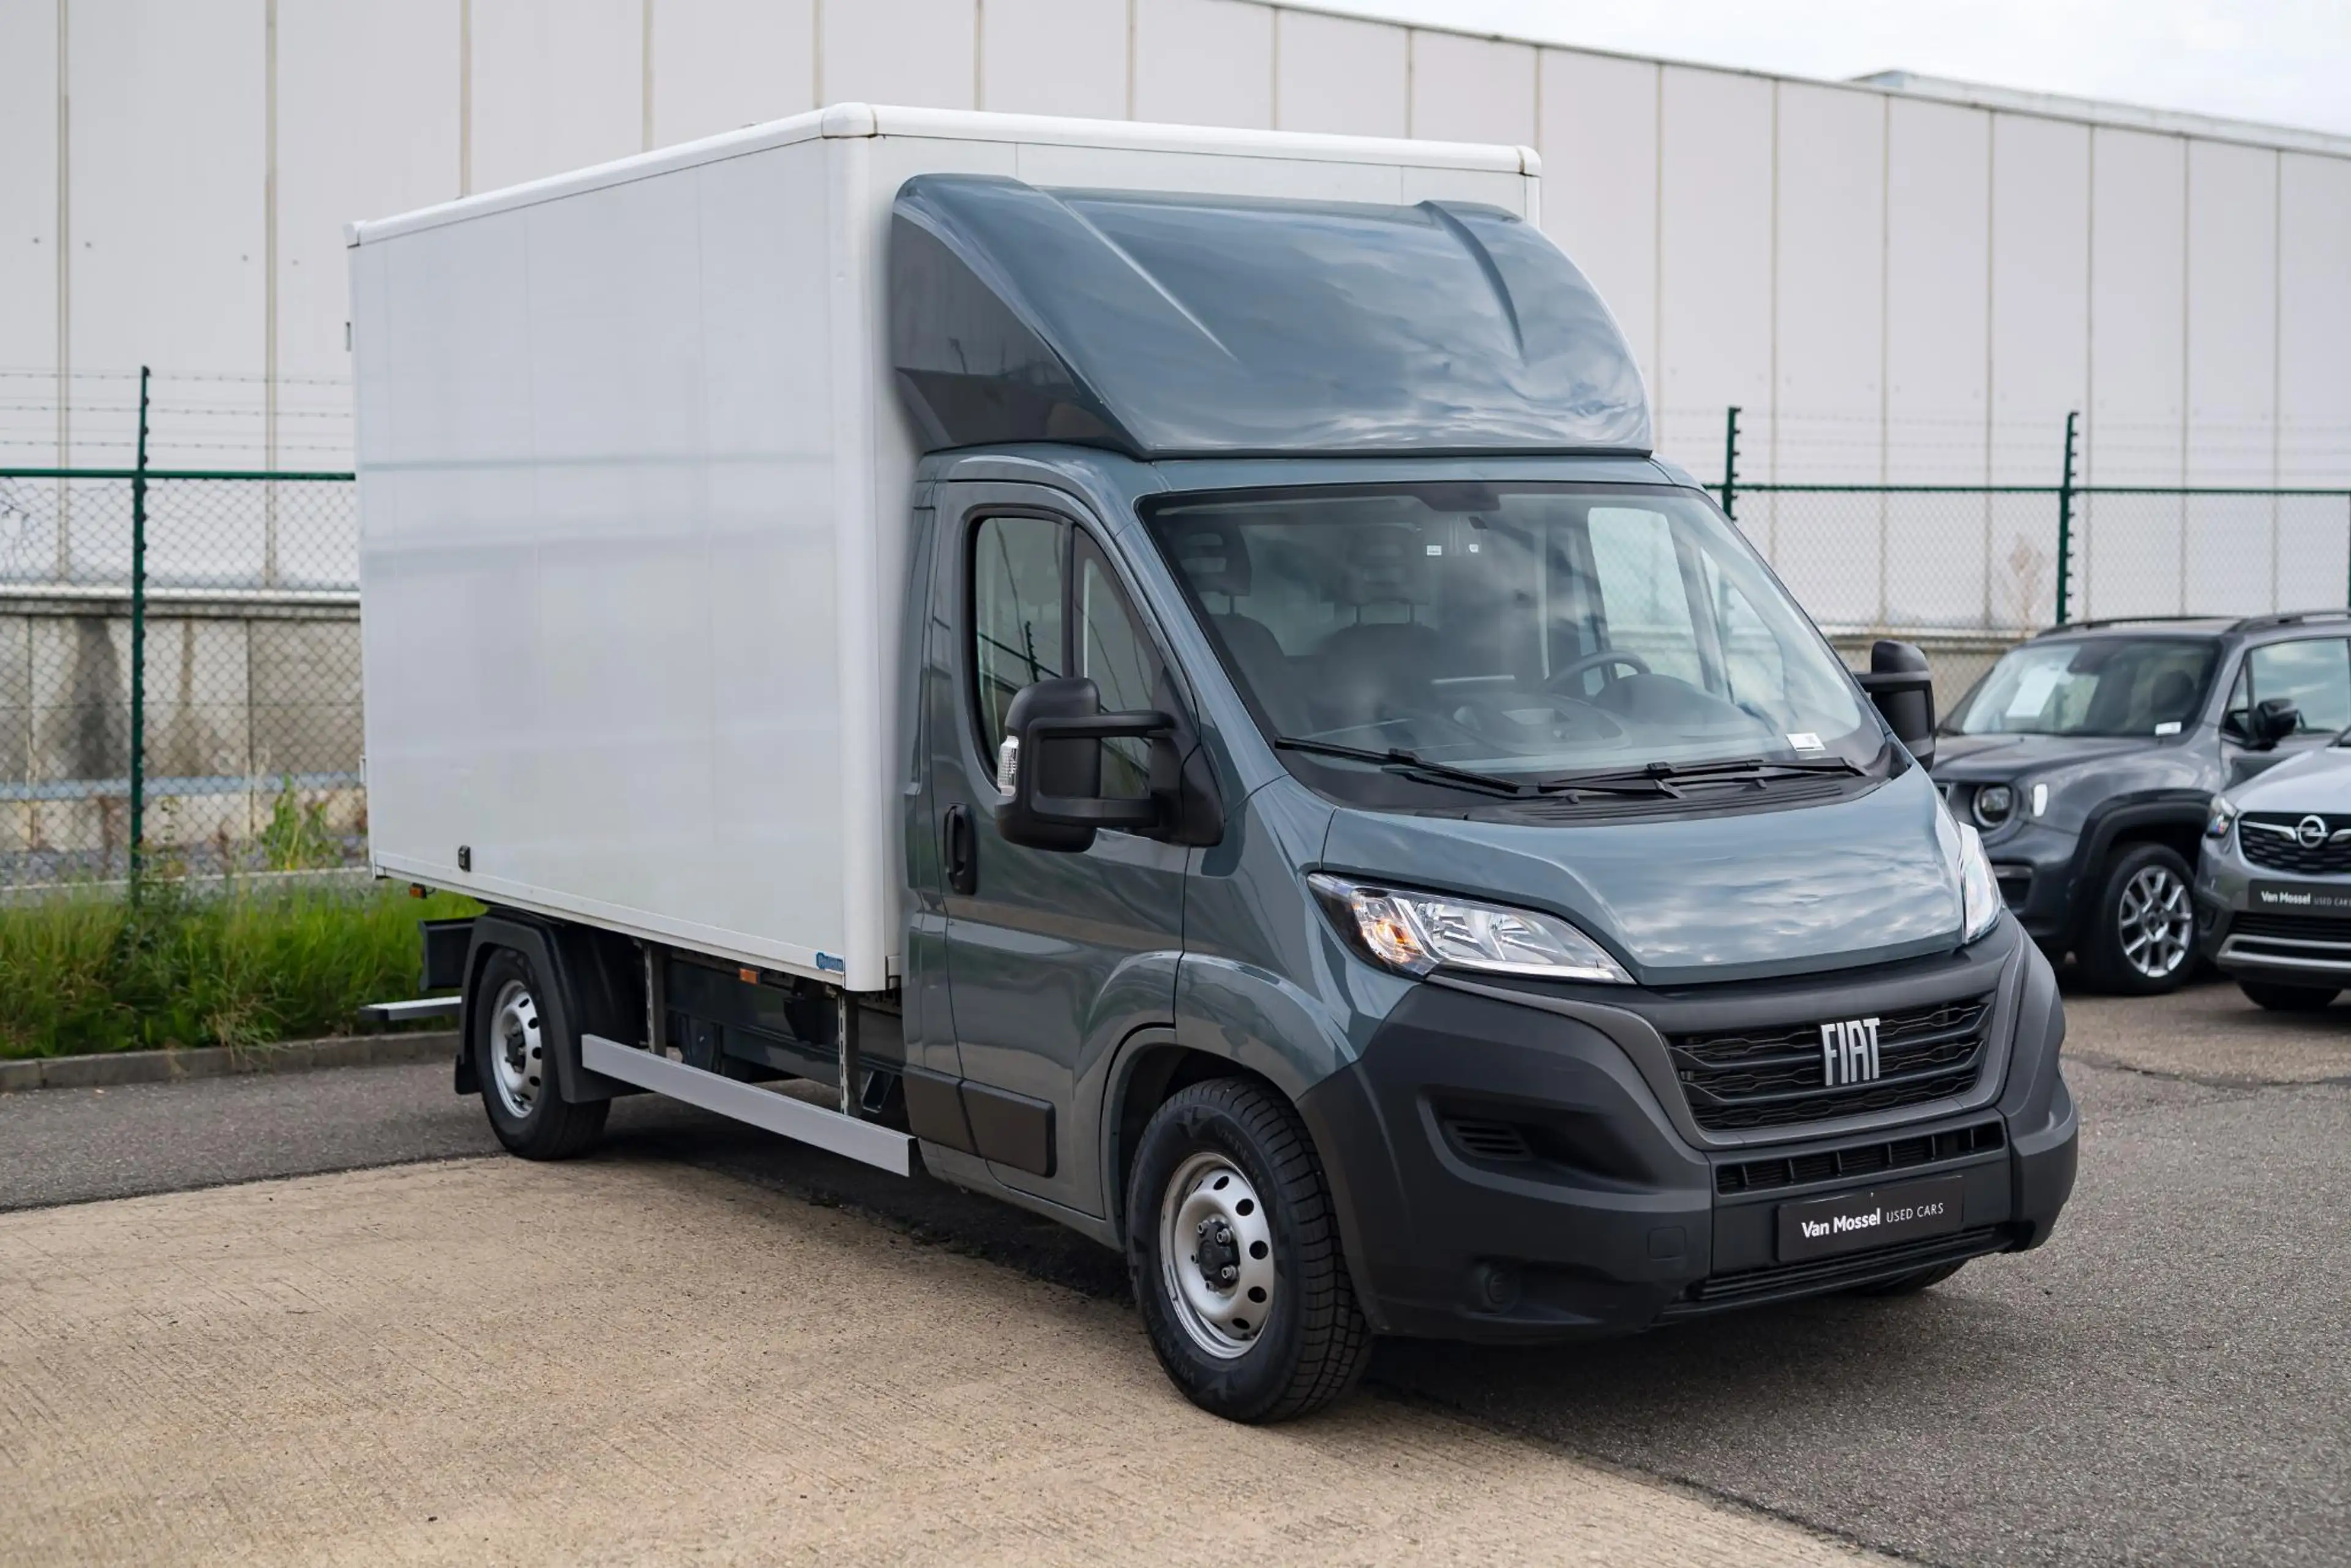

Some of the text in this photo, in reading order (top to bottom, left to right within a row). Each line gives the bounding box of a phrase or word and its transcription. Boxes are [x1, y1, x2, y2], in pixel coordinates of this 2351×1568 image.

[2261, 890, 2278, 902] Van
[2279, 891, 2311, 905] Mossel
[1821, 1018, 1880, 1087] FIAT
[1801, 1202, 1944, 1238] Van Mossel USED CARS
